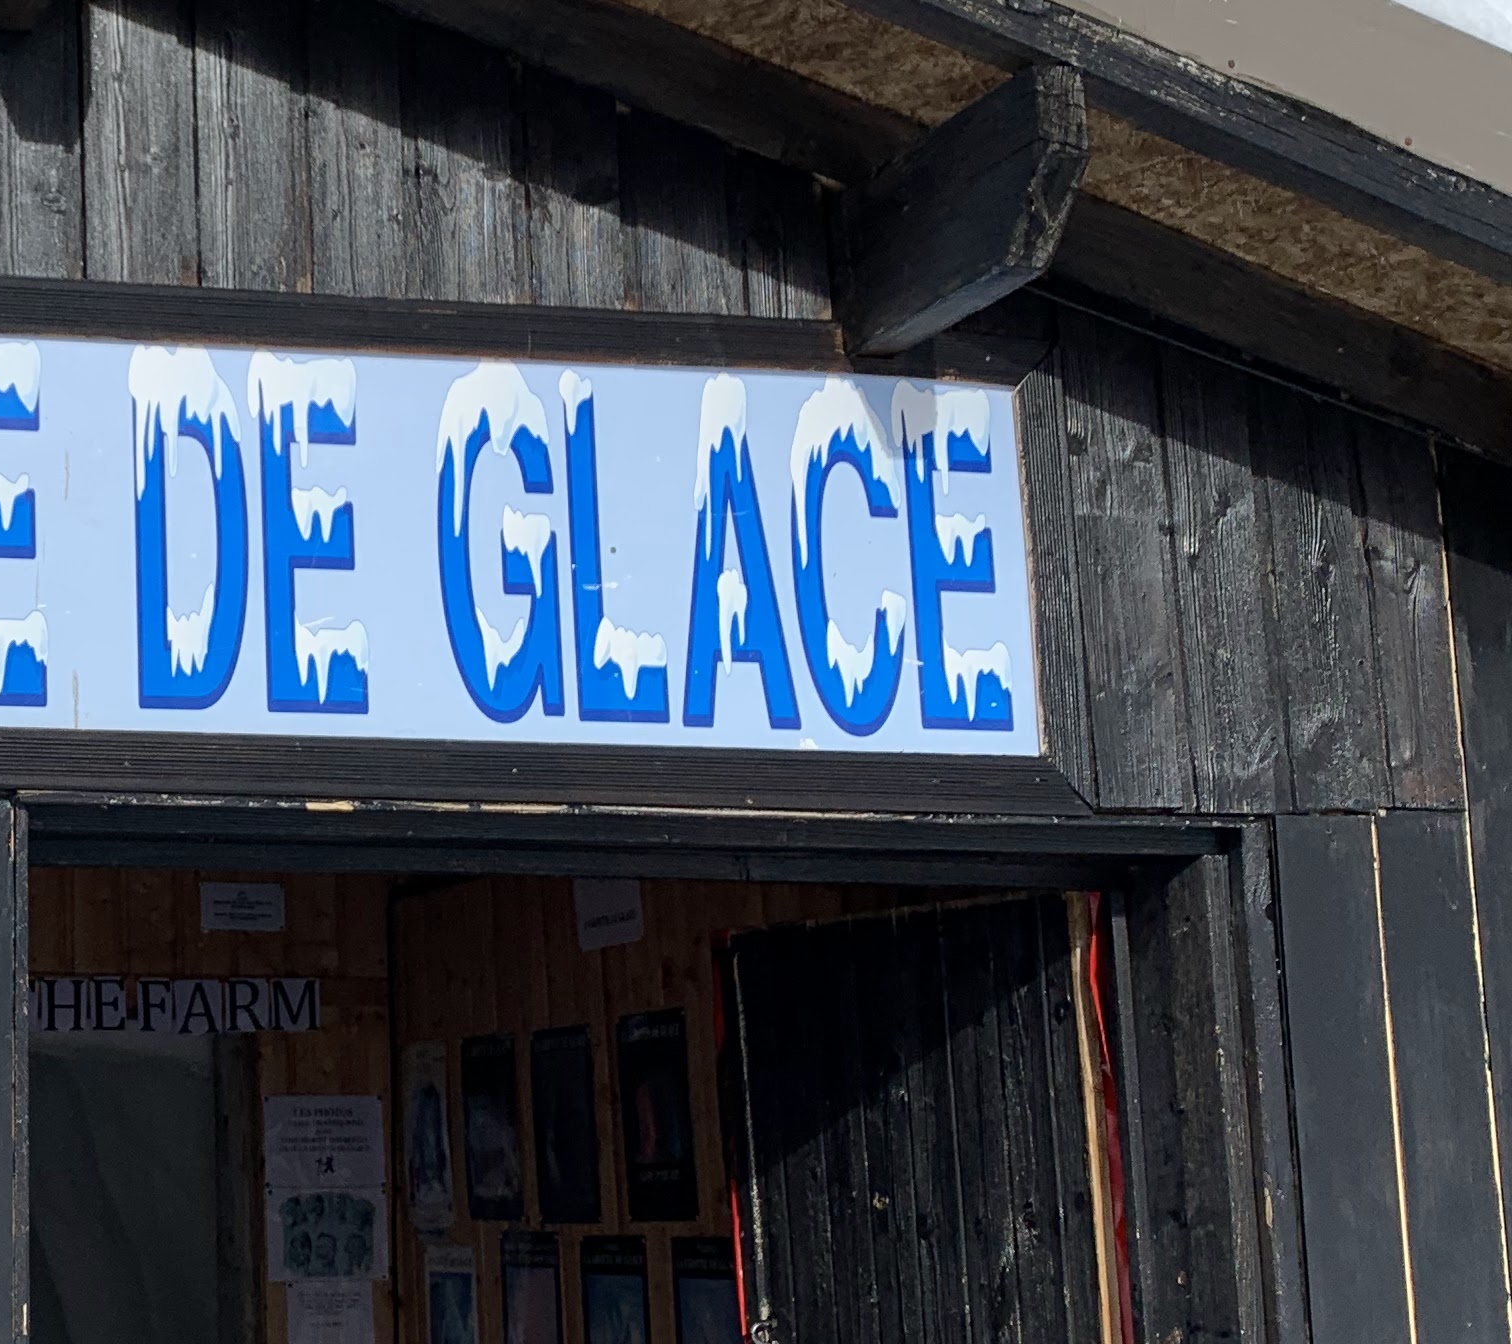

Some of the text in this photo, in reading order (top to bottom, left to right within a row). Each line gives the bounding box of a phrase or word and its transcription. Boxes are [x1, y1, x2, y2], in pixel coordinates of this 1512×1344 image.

[128, 342, 369, 714] DE
[436, 358, 1014, 736] GLACE
[29, 979, 319, 1033] HE FARM
